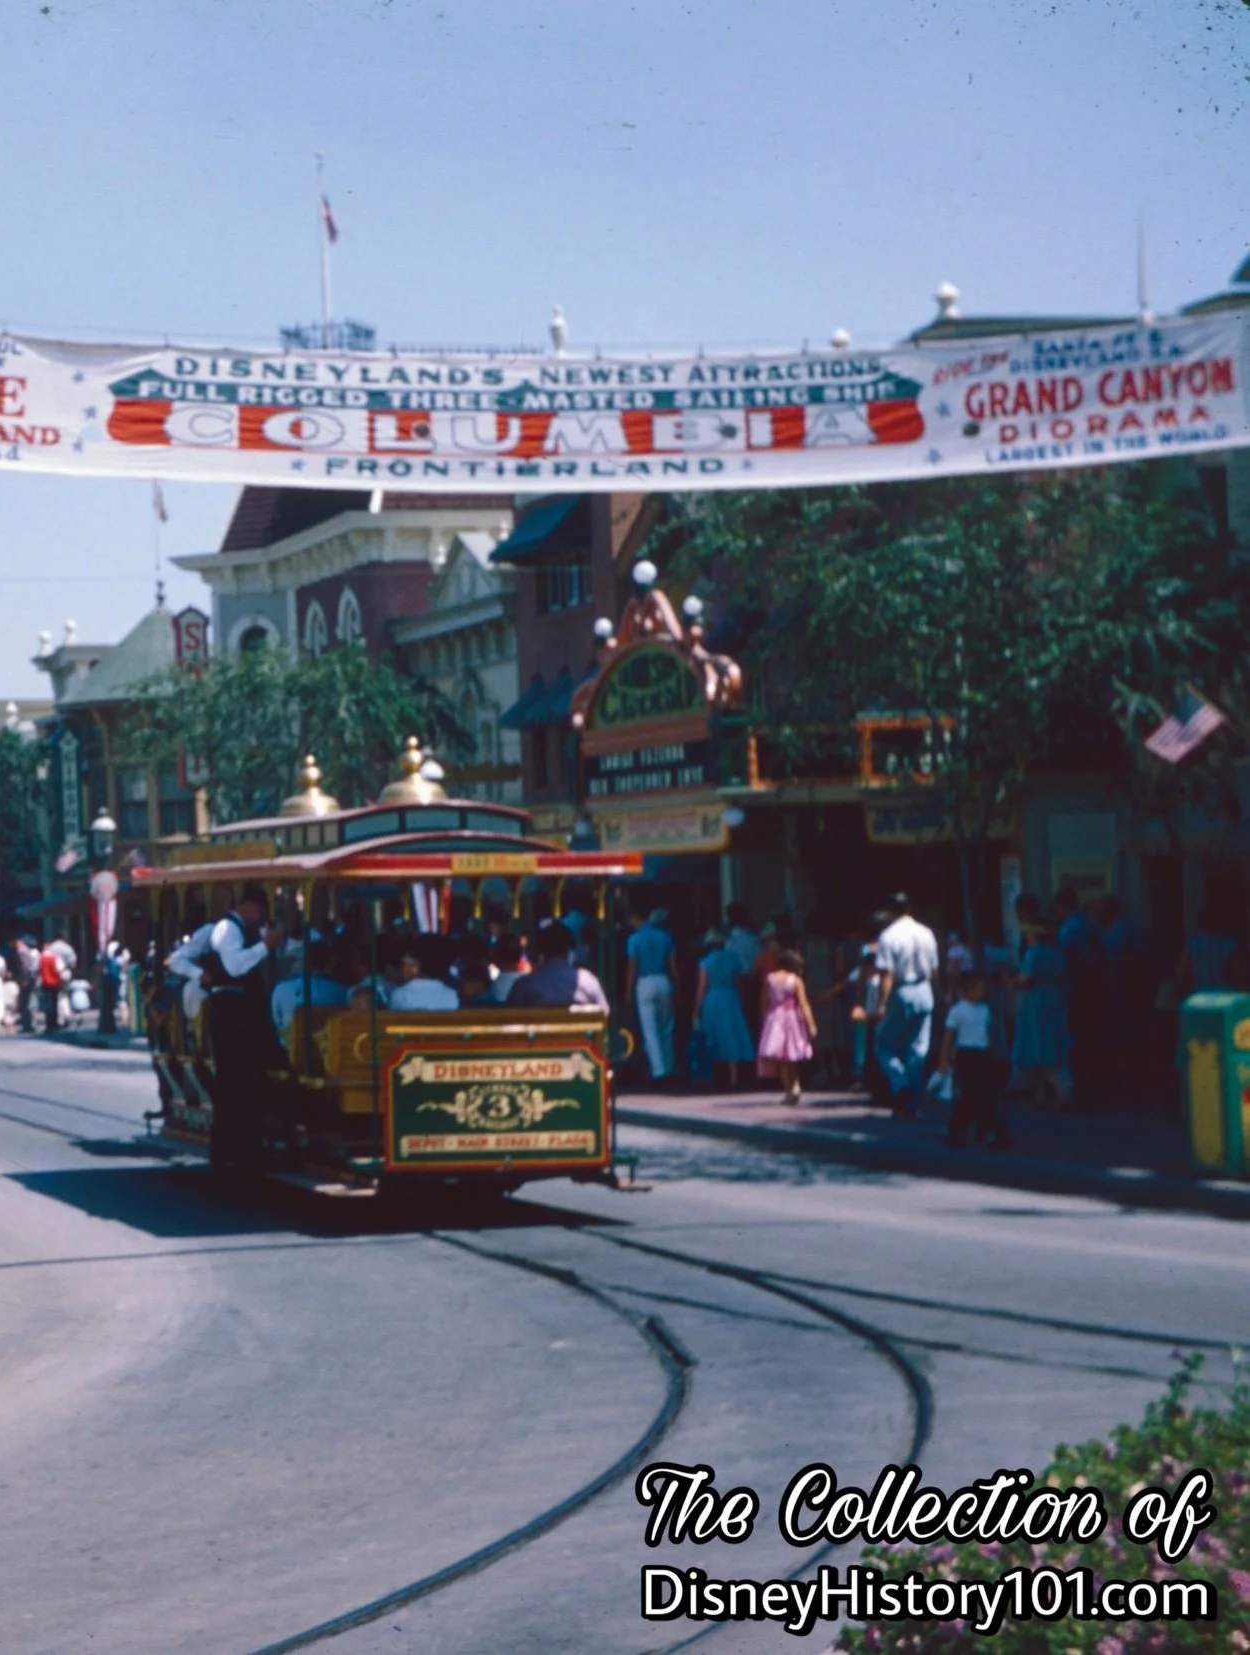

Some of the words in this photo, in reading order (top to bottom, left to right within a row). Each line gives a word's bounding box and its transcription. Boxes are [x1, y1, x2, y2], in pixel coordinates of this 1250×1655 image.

[175, 357, 505, 386] DISNEYLAND'S
[540, 362, 675, 386] NEWEST
[689, 358, 881, 383] ATTRACTIONS
[1009, 349, 1140, 374] DISNEYLAND
[138, 381, 227, 401] FULL
[238, 384, 369, 407] RIGGED
[674, 387, 808, 408] SAILING
[824, 381, 896, 402] SHIP
[964, 375, 1083, 421] GRAND
[1098, 356, 1235, 407] CANYON
[163, 402, 876, 453] COLUMBIA
[999, 406, 1209, 444] DIORAMA
[986, 441, 1073, 463] LARGEST
[1084, 440, 1103, 454] IN
[1113, 436, 1147, 451] THE
[1158, 425, 1227, 444] WORLD
[325, 457, 724, 477] FRONTIERLAND
[434, 1063, 562, 1079] DISNEYLAND
[487, 1095, 511, 1118] 3
